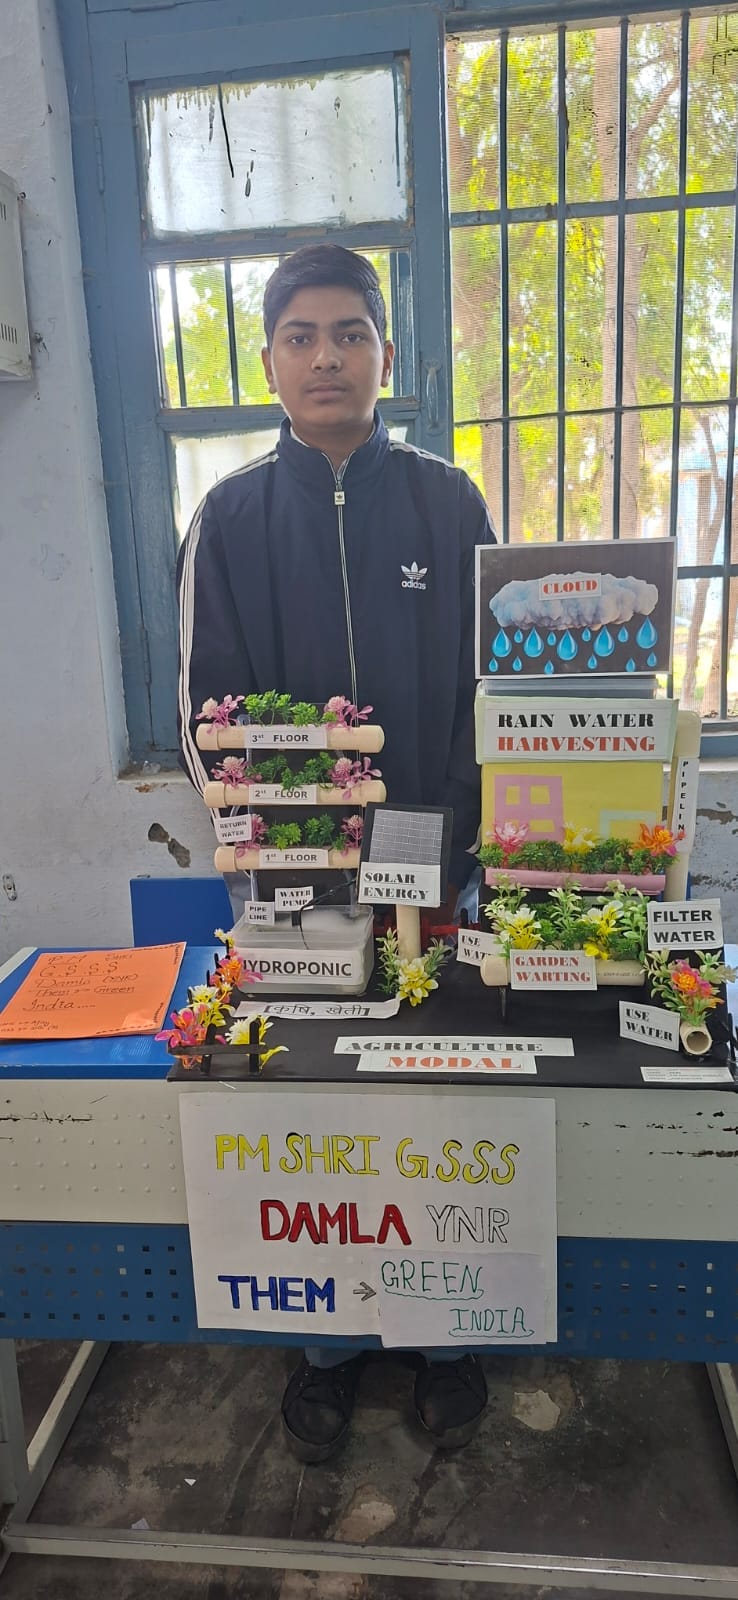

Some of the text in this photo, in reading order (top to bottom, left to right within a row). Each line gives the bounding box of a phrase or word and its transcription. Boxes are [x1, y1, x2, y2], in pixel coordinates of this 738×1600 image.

[401, 579, 427, 590] adidas
[542, 579, 598, 595] CLOUD
[498, 713, 654, 728] RAIN WATER
[273, 734, 309, 743] FLOOR
[497, 736, 655, 752] HARVESTING
[274, 789, 308, 799] FLOOR
[678, 761, 689, 840] PIPELIN
[219, 820, 247, 829] RETURN
[221, 830, 244, 838] WATER
[284, 854, 317, 862] FLOOR
[364, 872, 416, 884] SOLAR
[280, 890, 311, 898] WATER
[363, 887, 429, 900] ENERGY
[653, 910, 713, 922] FILTER
[461, 934, 480, 947] USE
[653, 931, 716, 944] WATER
[515, 957, 579, 967] GARDEN
[515, 971, 591, 983] WARTING
[626, 1008, 650, 1021] USE
[625, 1022, 673, 1042] WATER
[345, 1042, 543, 1052] AGRICULTURE
[386, 1056, 521, 1069] MODAL
[215, 1134, 271, 1173] PM
[279, 1132, 381, 1176] SHRI
[260, 1200, 510, 1246] DAMLA YNR
[381, 1260, 483, 1294] GREEN
[217, 1275, 336, 1313] THEM
[450, 1307, 529, 1333] INDIA
